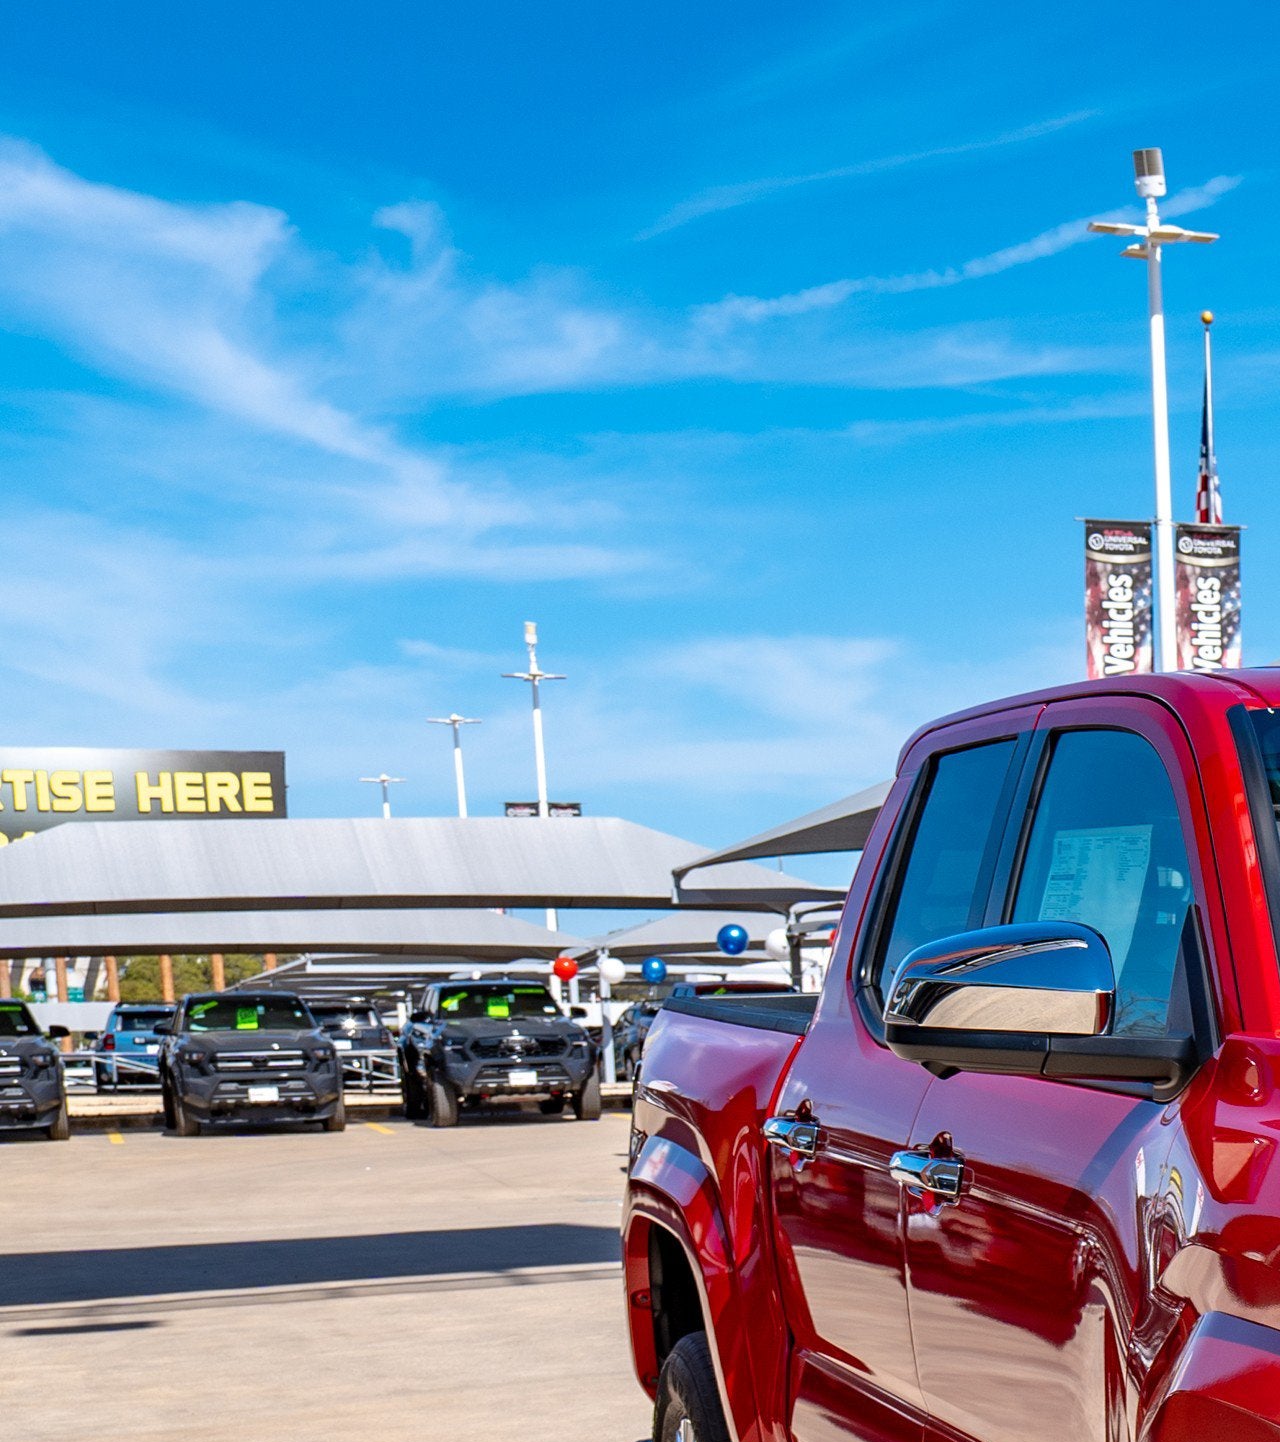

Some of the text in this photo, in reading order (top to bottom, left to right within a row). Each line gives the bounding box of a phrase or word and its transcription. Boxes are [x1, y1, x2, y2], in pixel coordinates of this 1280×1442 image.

[1104, 535, 1148, 545] UNIVERSAL
[1105, 543, 1134, 551] TOYOTA
[1101, 573, 1135, 675] Vehicles
[0, 769, 274, 813] TISE HERE
